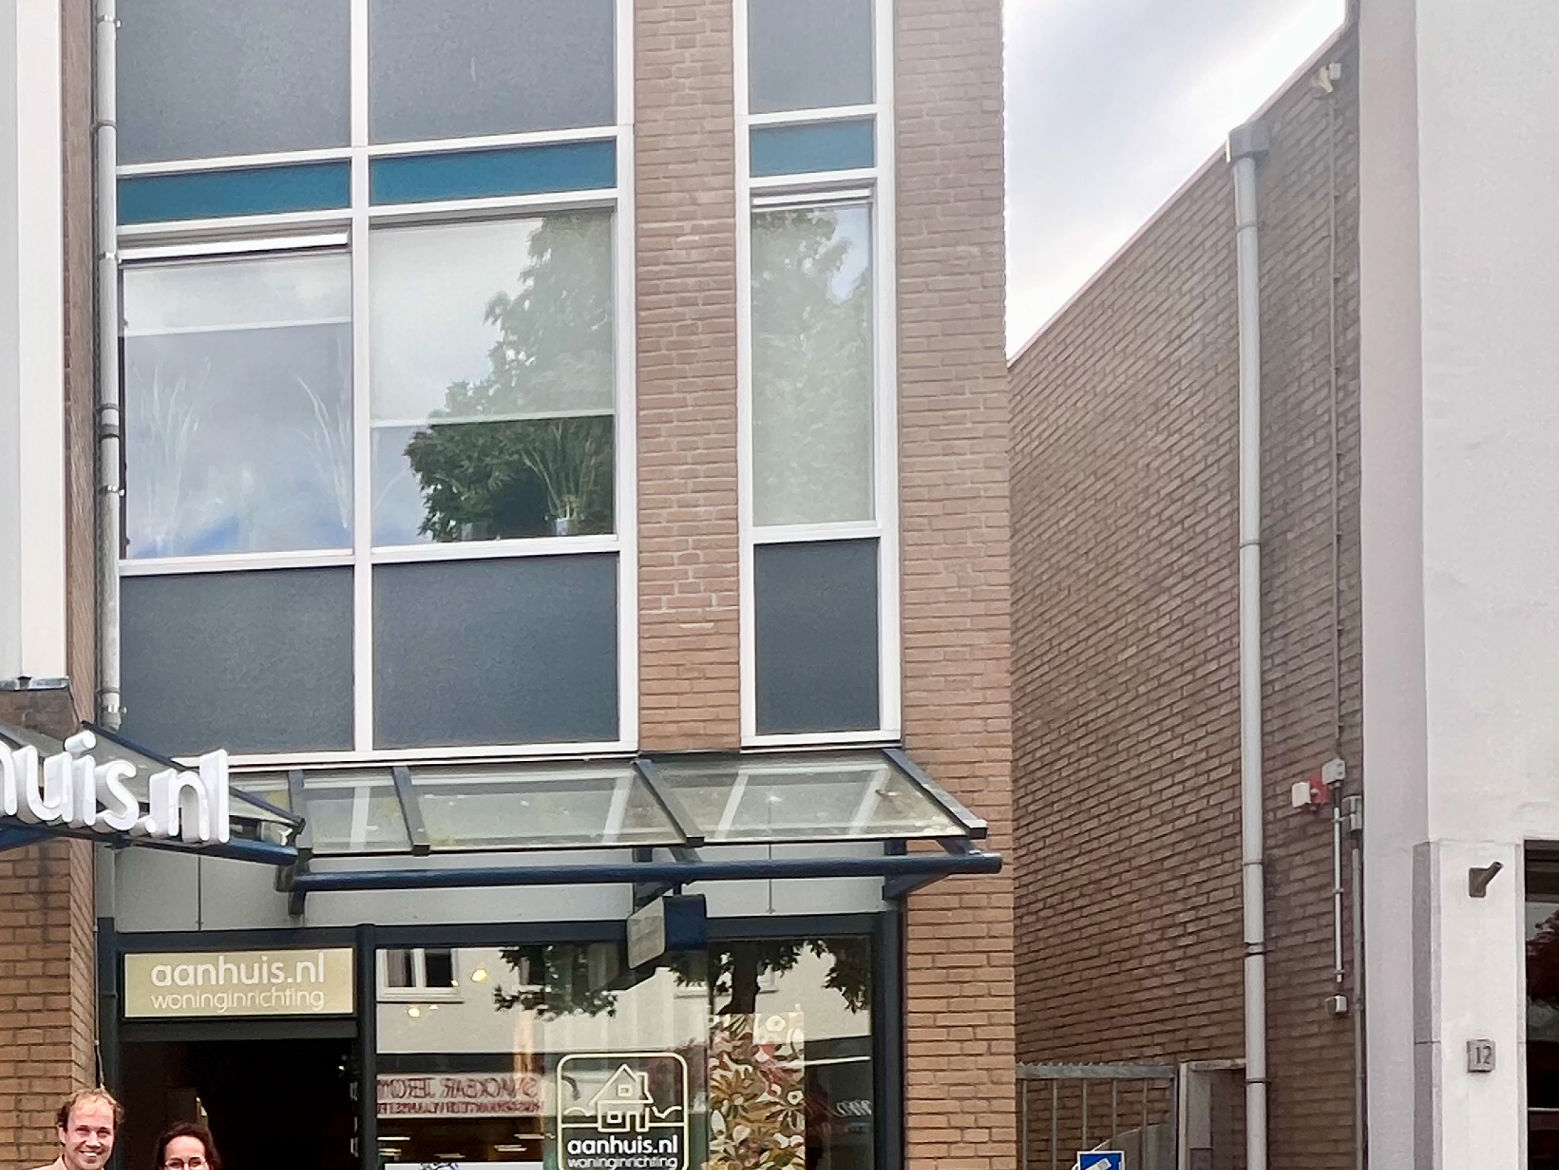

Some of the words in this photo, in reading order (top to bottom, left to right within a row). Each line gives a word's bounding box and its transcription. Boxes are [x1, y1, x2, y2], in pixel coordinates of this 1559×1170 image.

[150, 952, 325, 987] aanhuis.nl
[150, 987, 326, 1013] woninginrichting
[1475, 1045, 1492, 1065] 12
[567, 1134, 679, 1155] aanhuis.nl
[567, 1155, 679, 1170] woninginrichting
